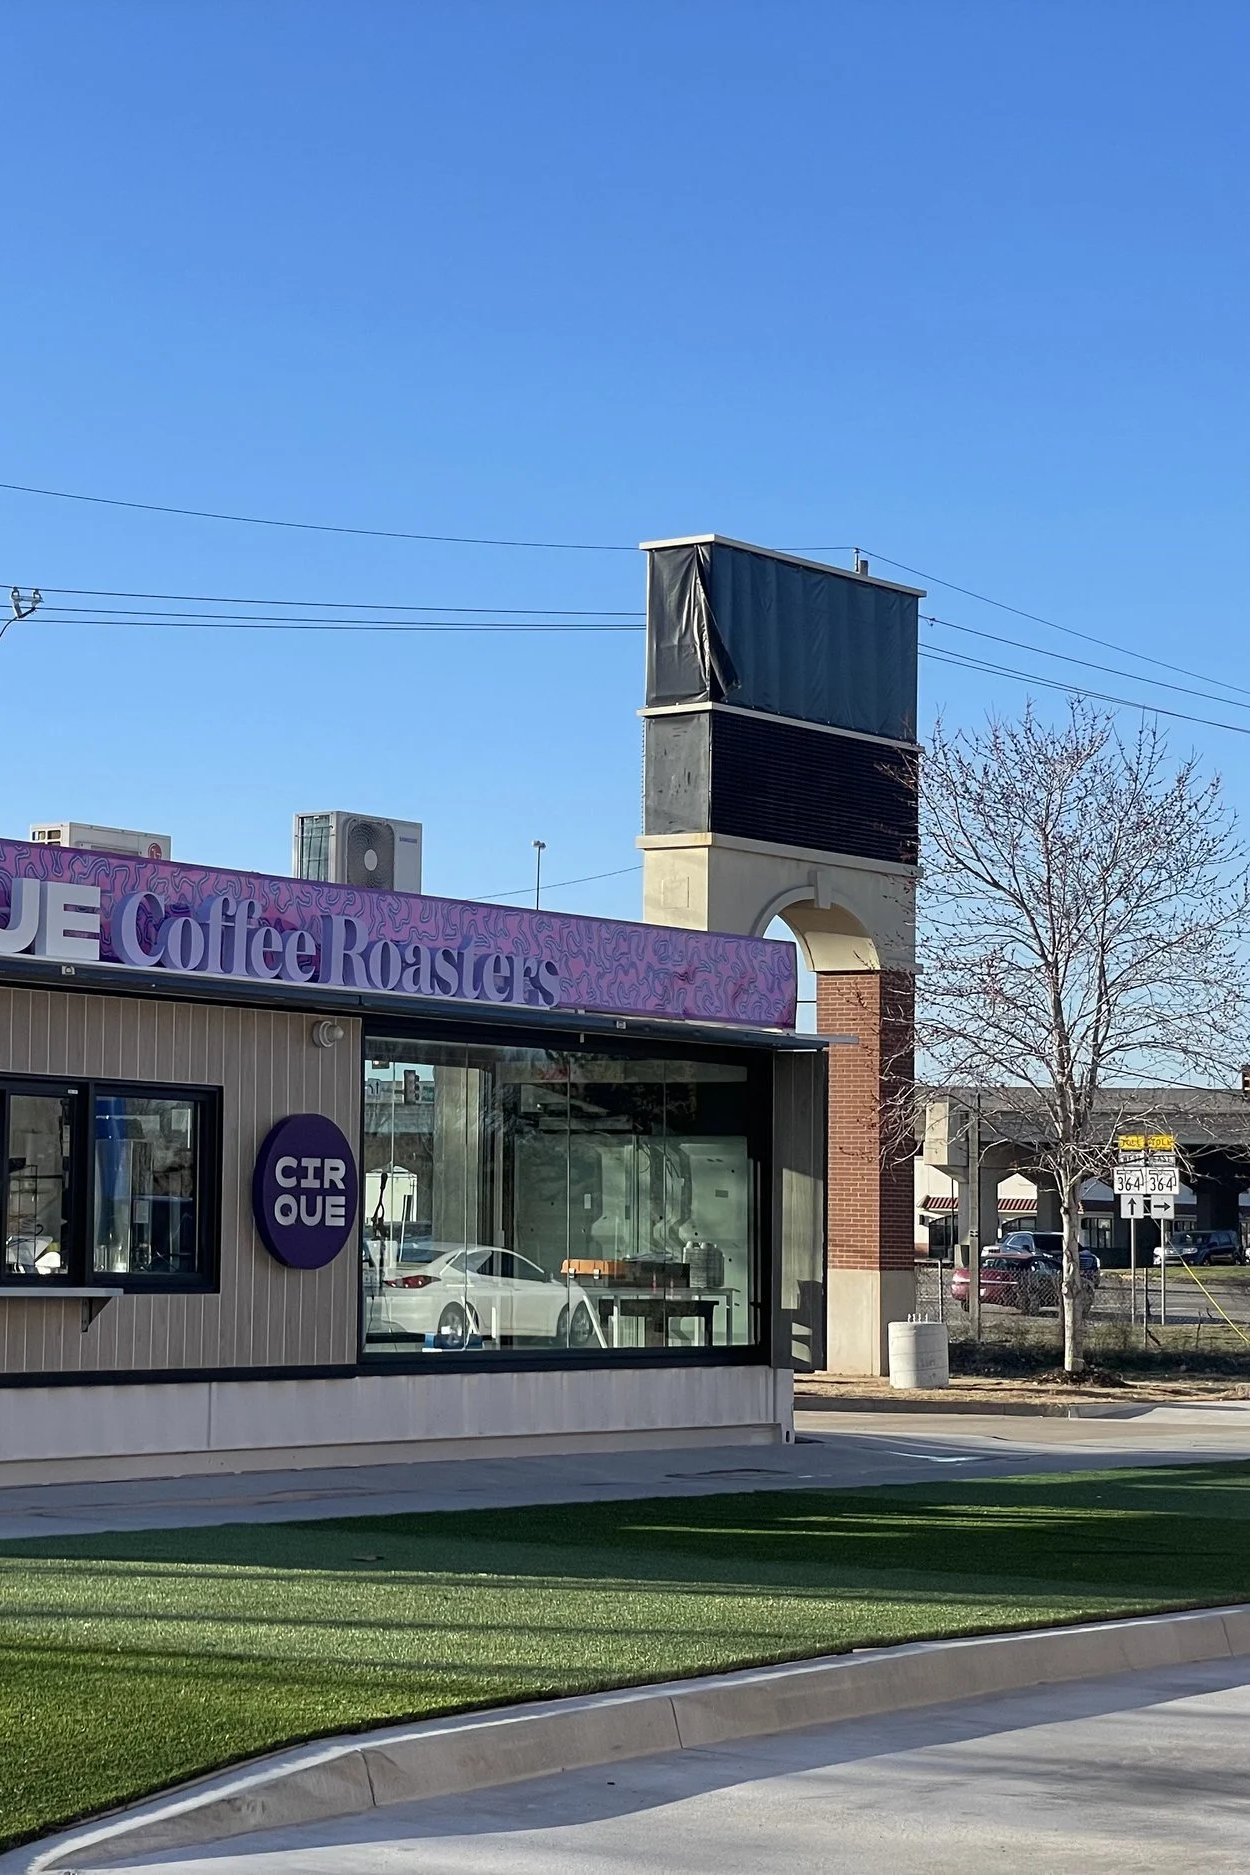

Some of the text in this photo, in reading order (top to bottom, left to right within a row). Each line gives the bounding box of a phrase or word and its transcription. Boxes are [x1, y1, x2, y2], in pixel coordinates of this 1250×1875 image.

[113, 891, 317, 982] Coffee
[318, 914, 560, 1008] Roasters
[275, 1156, 346, 1190] CIR
[1117, 1176, 1140, 1191] 364
[1149, 1176, 1173, 1191] 364
[274, 1194, 346, 1227] QUE
